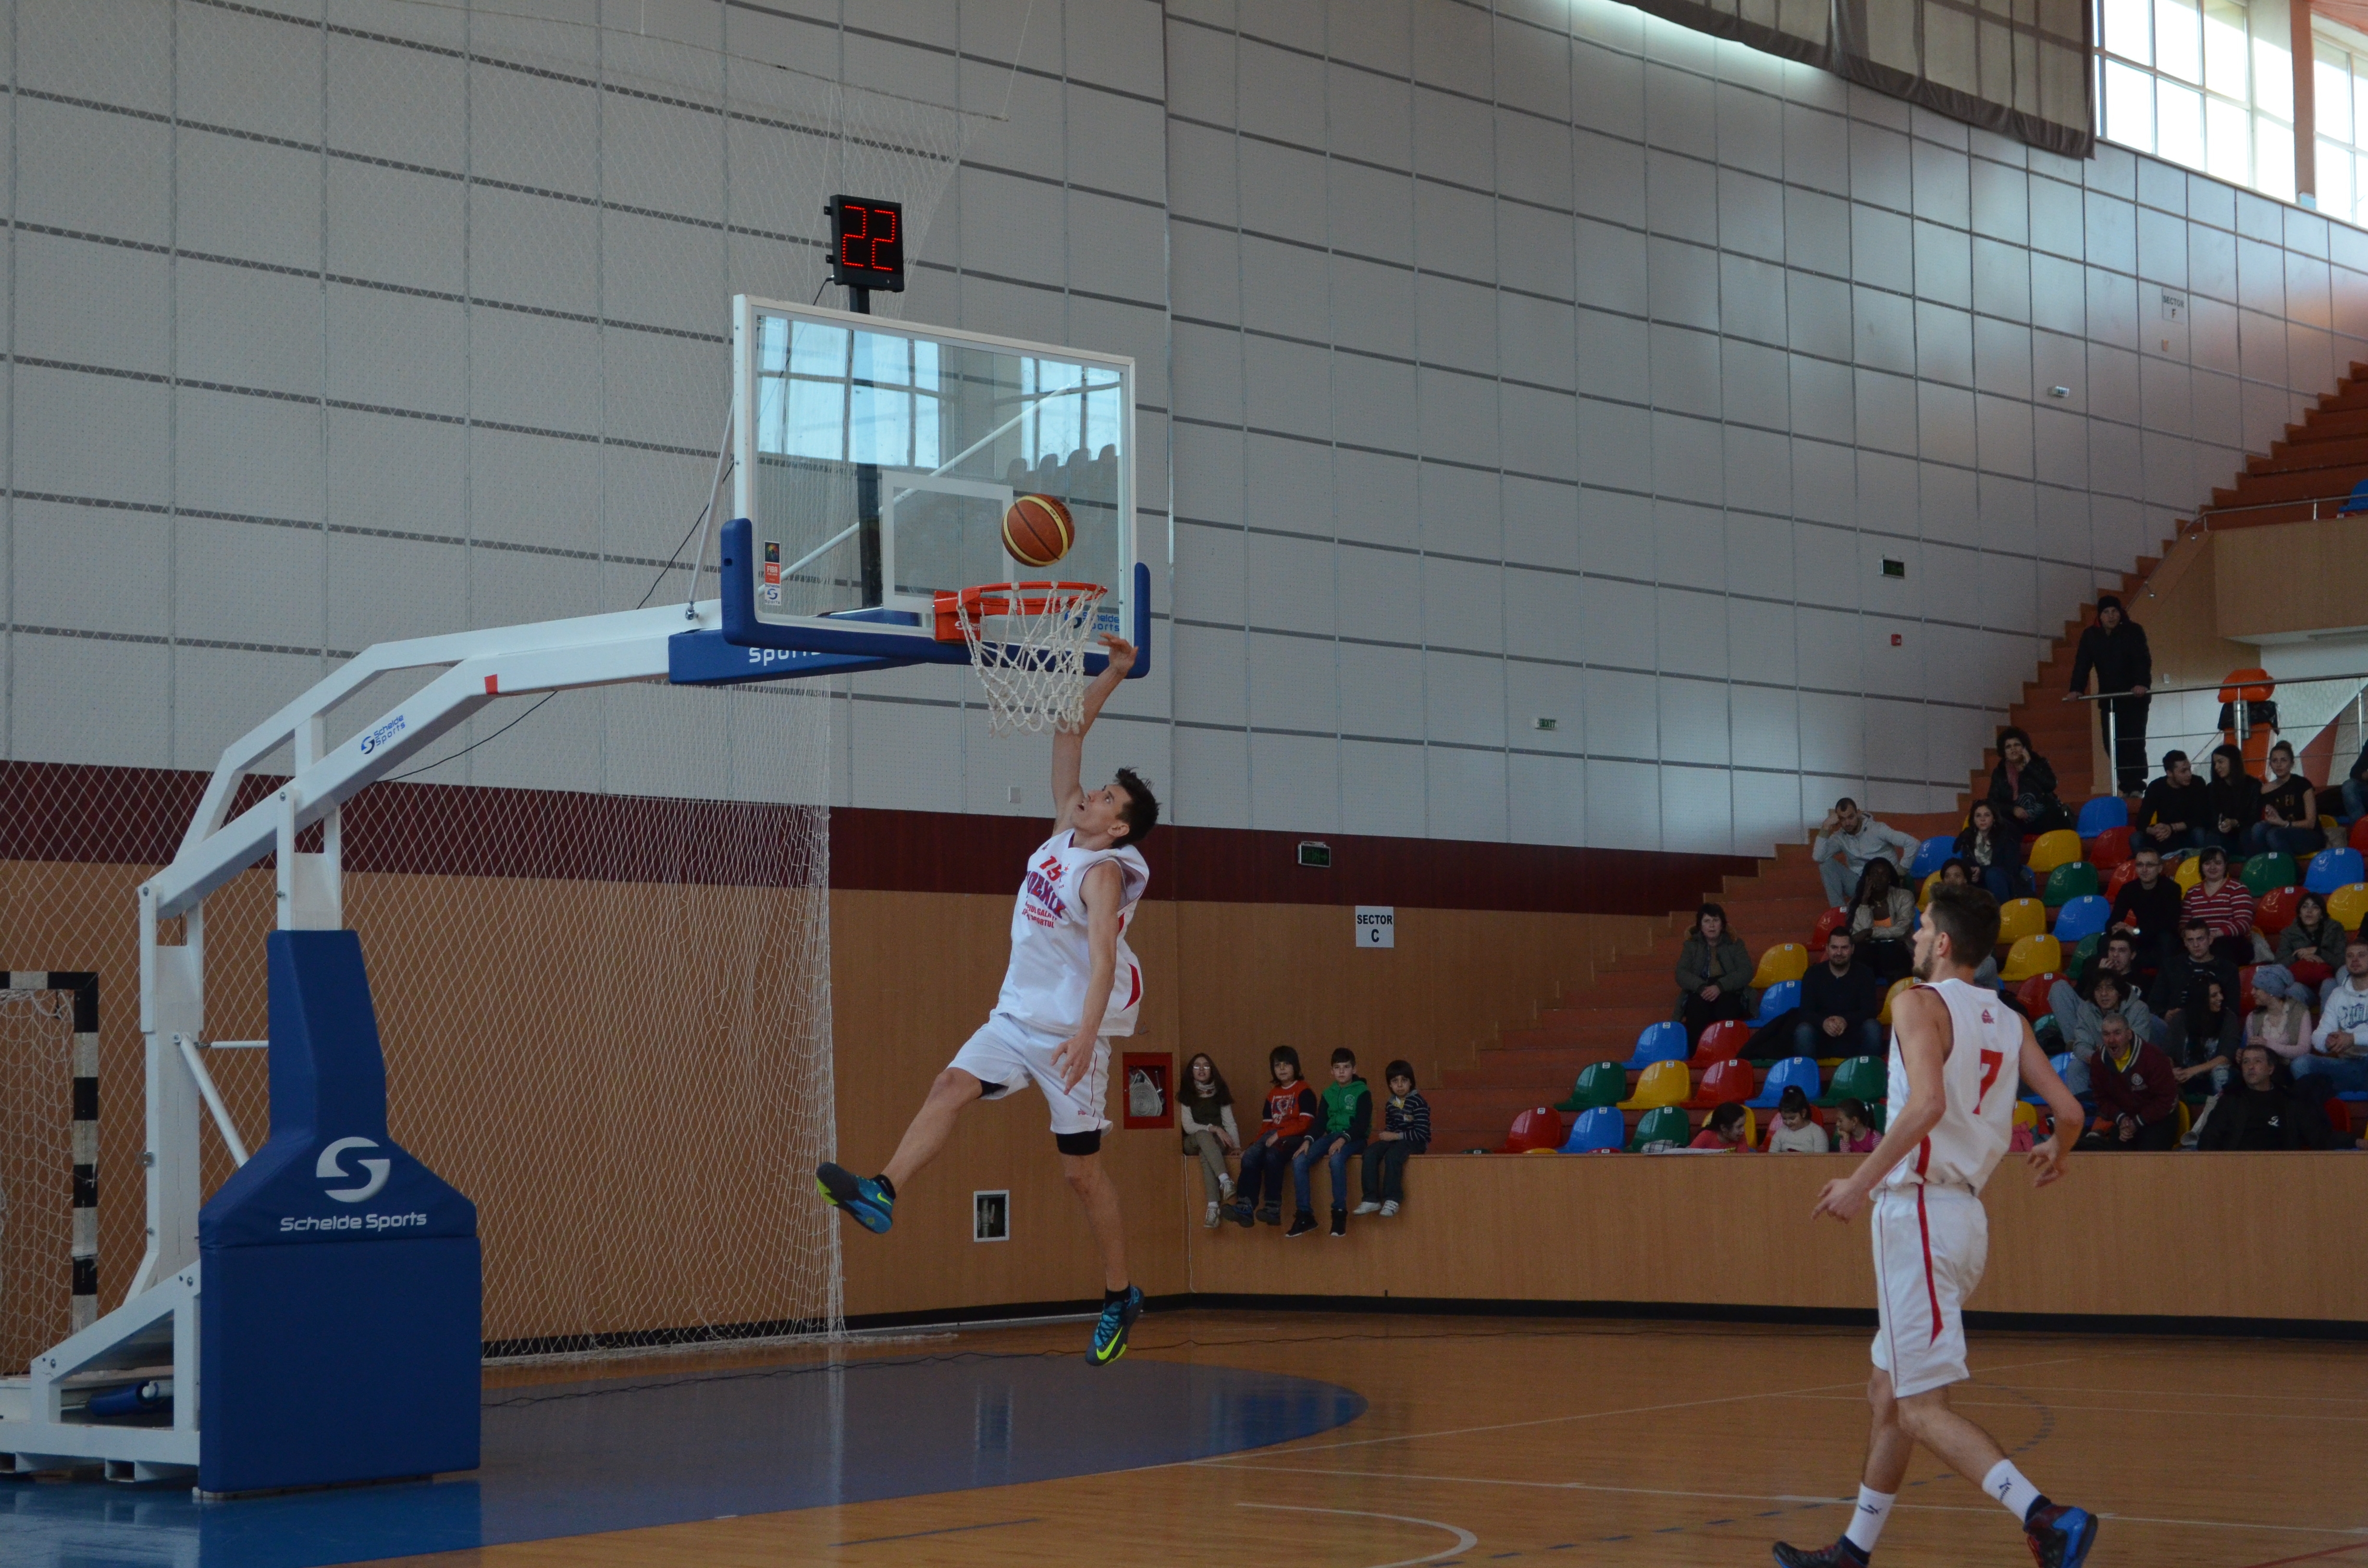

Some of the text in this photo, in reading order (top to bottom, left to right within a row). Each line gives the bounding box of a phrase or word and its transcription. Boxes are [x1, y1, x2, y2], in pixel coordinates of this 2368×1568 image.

[842, 205, 897, 271] 22
[767, 565, 778, 574] FIBA
[374, 715, 404, 739] Schelde
[375, 722, 406, 746] Sports
[1357, 915, 1393, 925] SECTOR
[1371, 929, 1380, 943] C
[1973, 1048, 2004, 1115] 7
[280, 1212, 427, 1232] Schelde Sports
